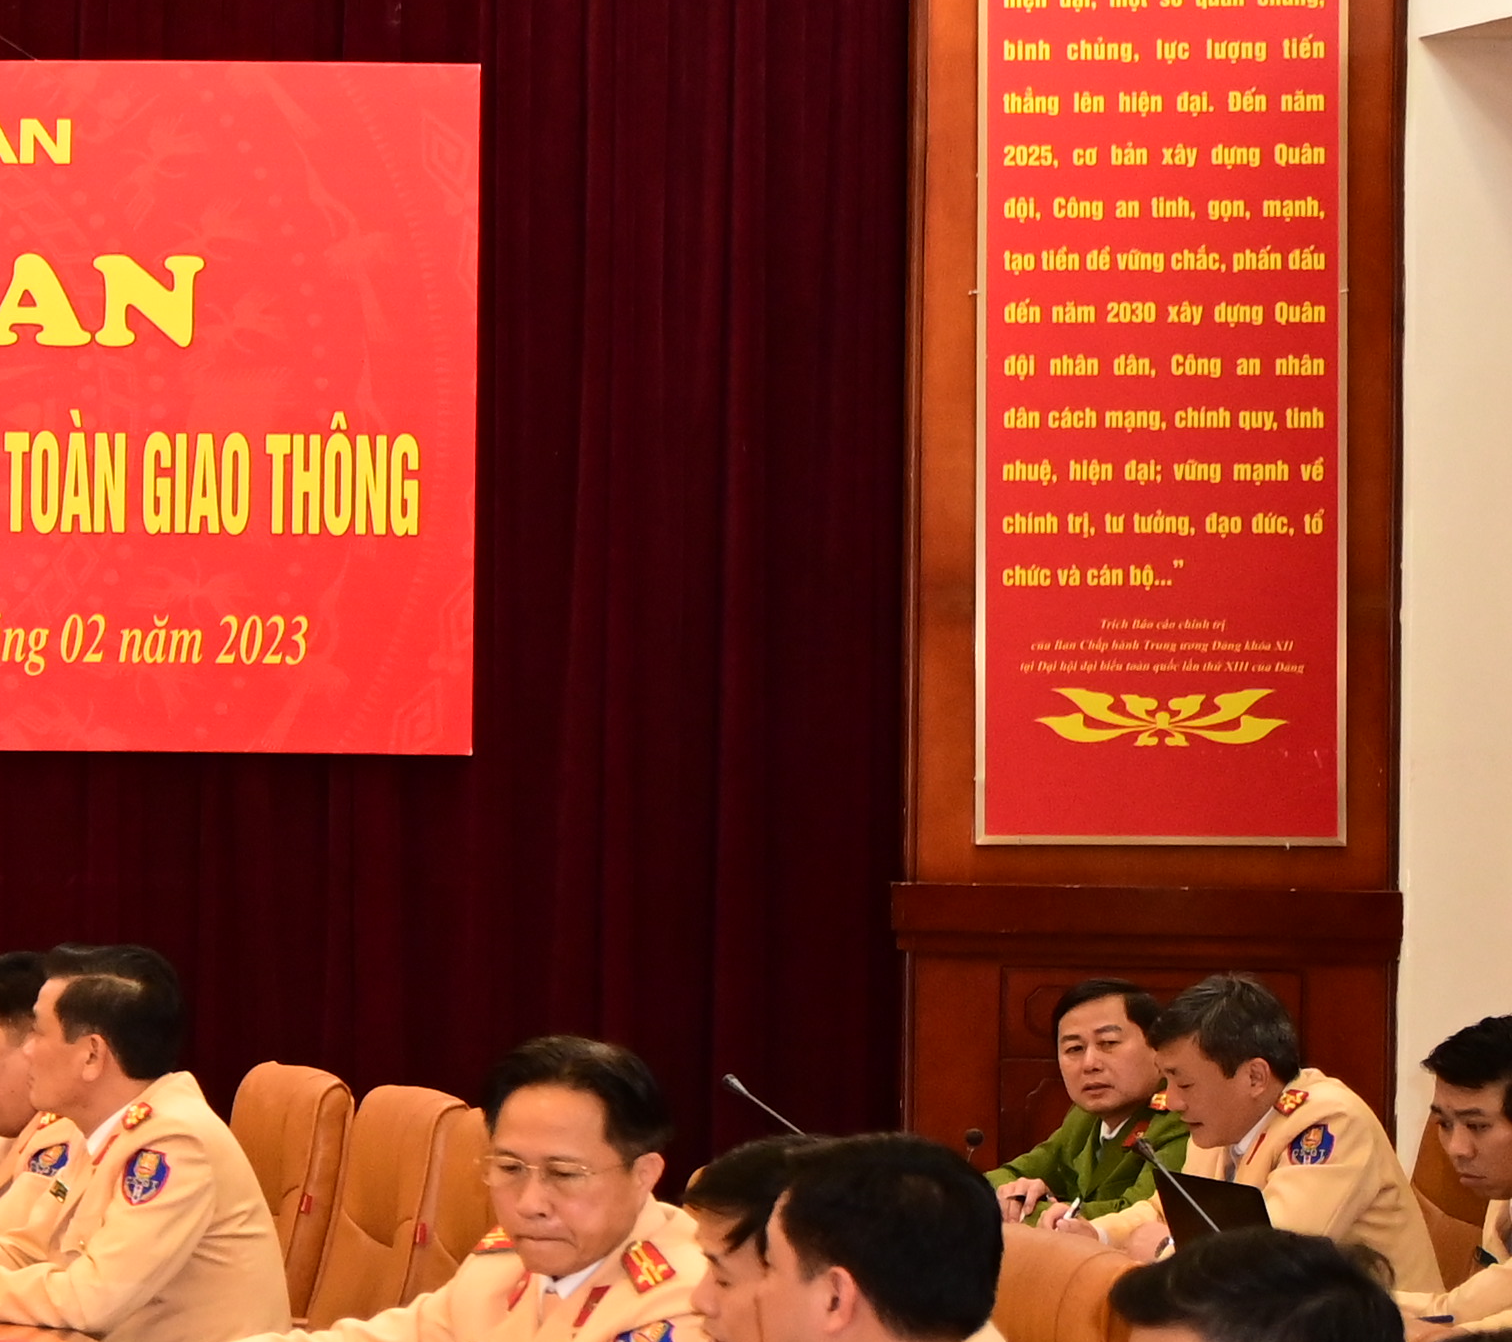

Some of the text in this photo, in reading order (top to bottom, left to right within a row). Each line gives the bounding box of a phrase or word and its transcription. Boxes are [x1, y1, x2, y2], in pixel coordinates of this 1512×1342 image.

[1003, 141, 1326, 170] 2025, cơ bản xây dựng Quân
[4, 408, 127, 534] TOÀN
[142, 431, 250, 536] GIAO
[265, 410, 419, 537] THÔNG
[1002, 564, 1051, 587] chức
[1056, 564, 1081, 587] và
[1086, 563, 1124, 586] cán
[60, 613, 106, 664] 02
[118, 614, 203, 664] năm
[215, 614, 309, 666] 2023
